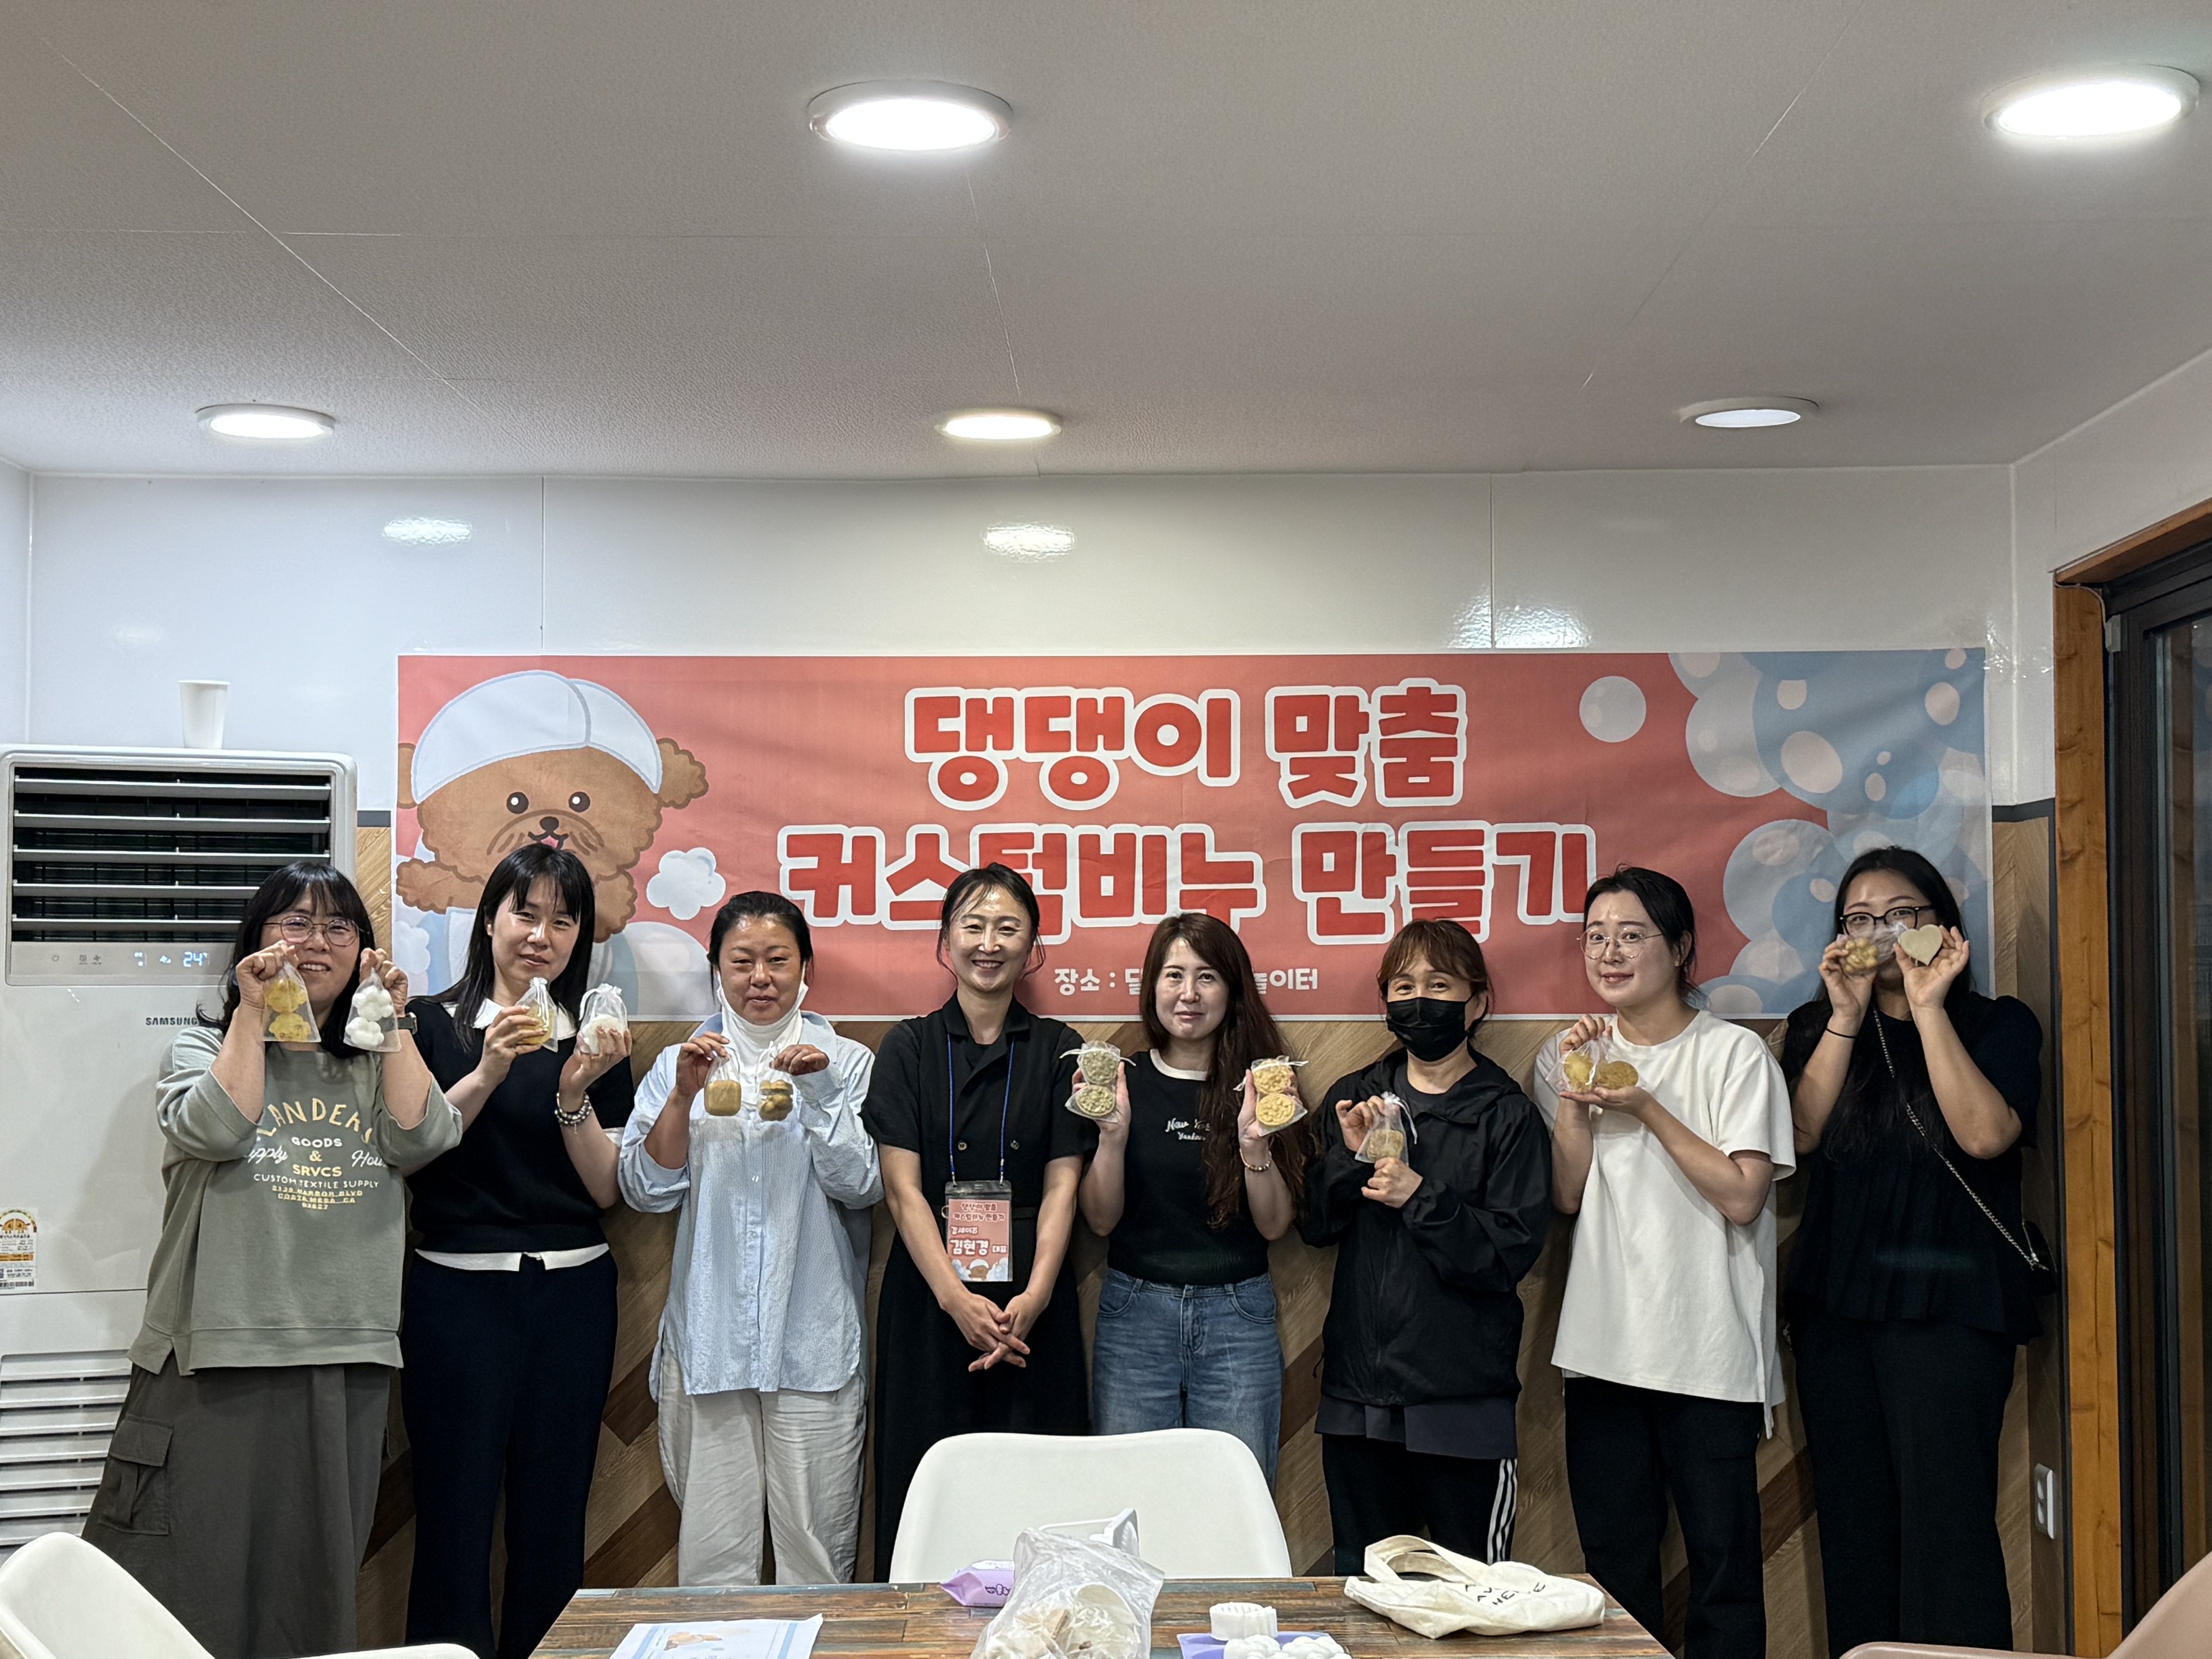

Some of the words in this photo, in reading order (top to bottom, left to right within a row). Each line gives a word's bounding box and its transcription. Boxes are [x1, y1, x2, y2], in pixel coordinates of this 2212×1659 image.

[905, 687, 1240, 810] 댕댕이
[1265, 677, 1467, 807] 맞춤
[778, 823, 1266, 944] 커스텀비누
[1291, 821, 1596, 944] 만들기
[1054, 968, 1100, 995] 장소
[146, 1017, 198, 1025] SAMSUNG
[292, 1137, 342, 1147] GOODS
[309, 1151, 322, 1162] &
[351, 1150, 388, 1168] Hou
[293, 1164, 342, 1177] SRVCS
[254, 1174, 297, 1185] CUSTOM
[300, 1180, 338, 1188] TEXTILE
[950, 1240, 989, 1255] 김현경
